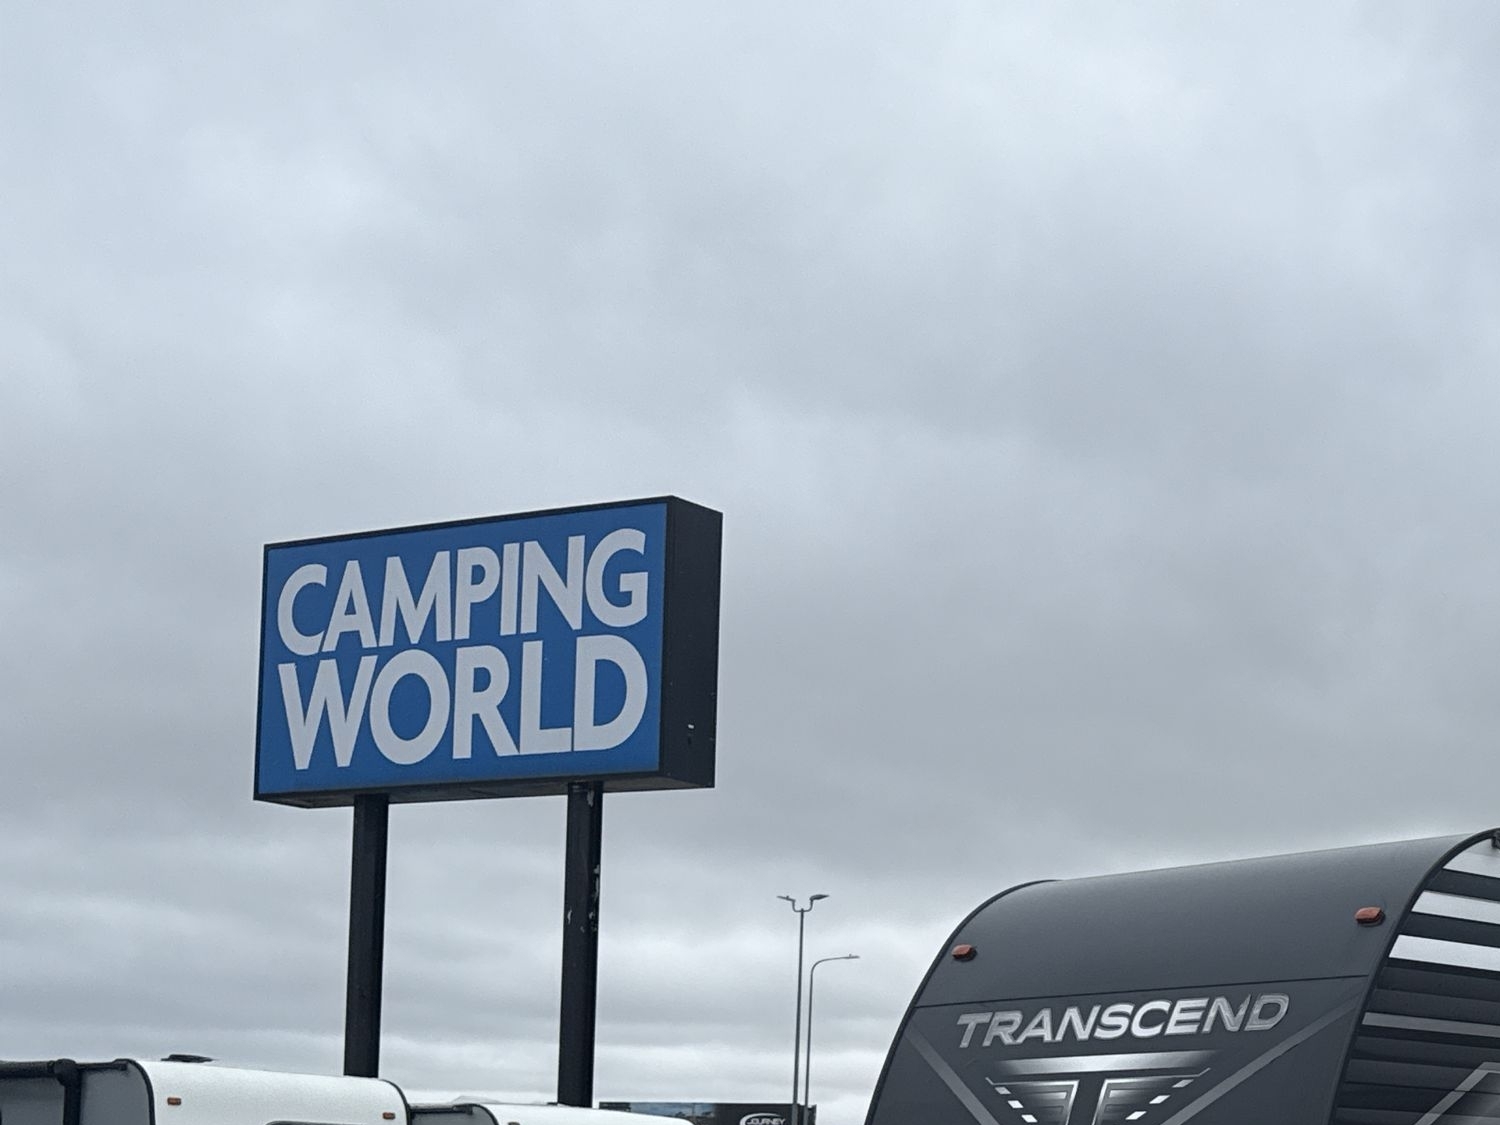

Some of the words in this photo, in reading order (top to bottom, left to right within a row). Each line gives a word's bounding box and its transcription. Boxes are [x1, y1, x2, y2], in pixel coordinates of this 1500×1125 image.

[277, 528, 648, 656] CAMPING
[278, 634, 648, 770] WORLD
[956, 993, 1290, 1049] TRANSCEND
